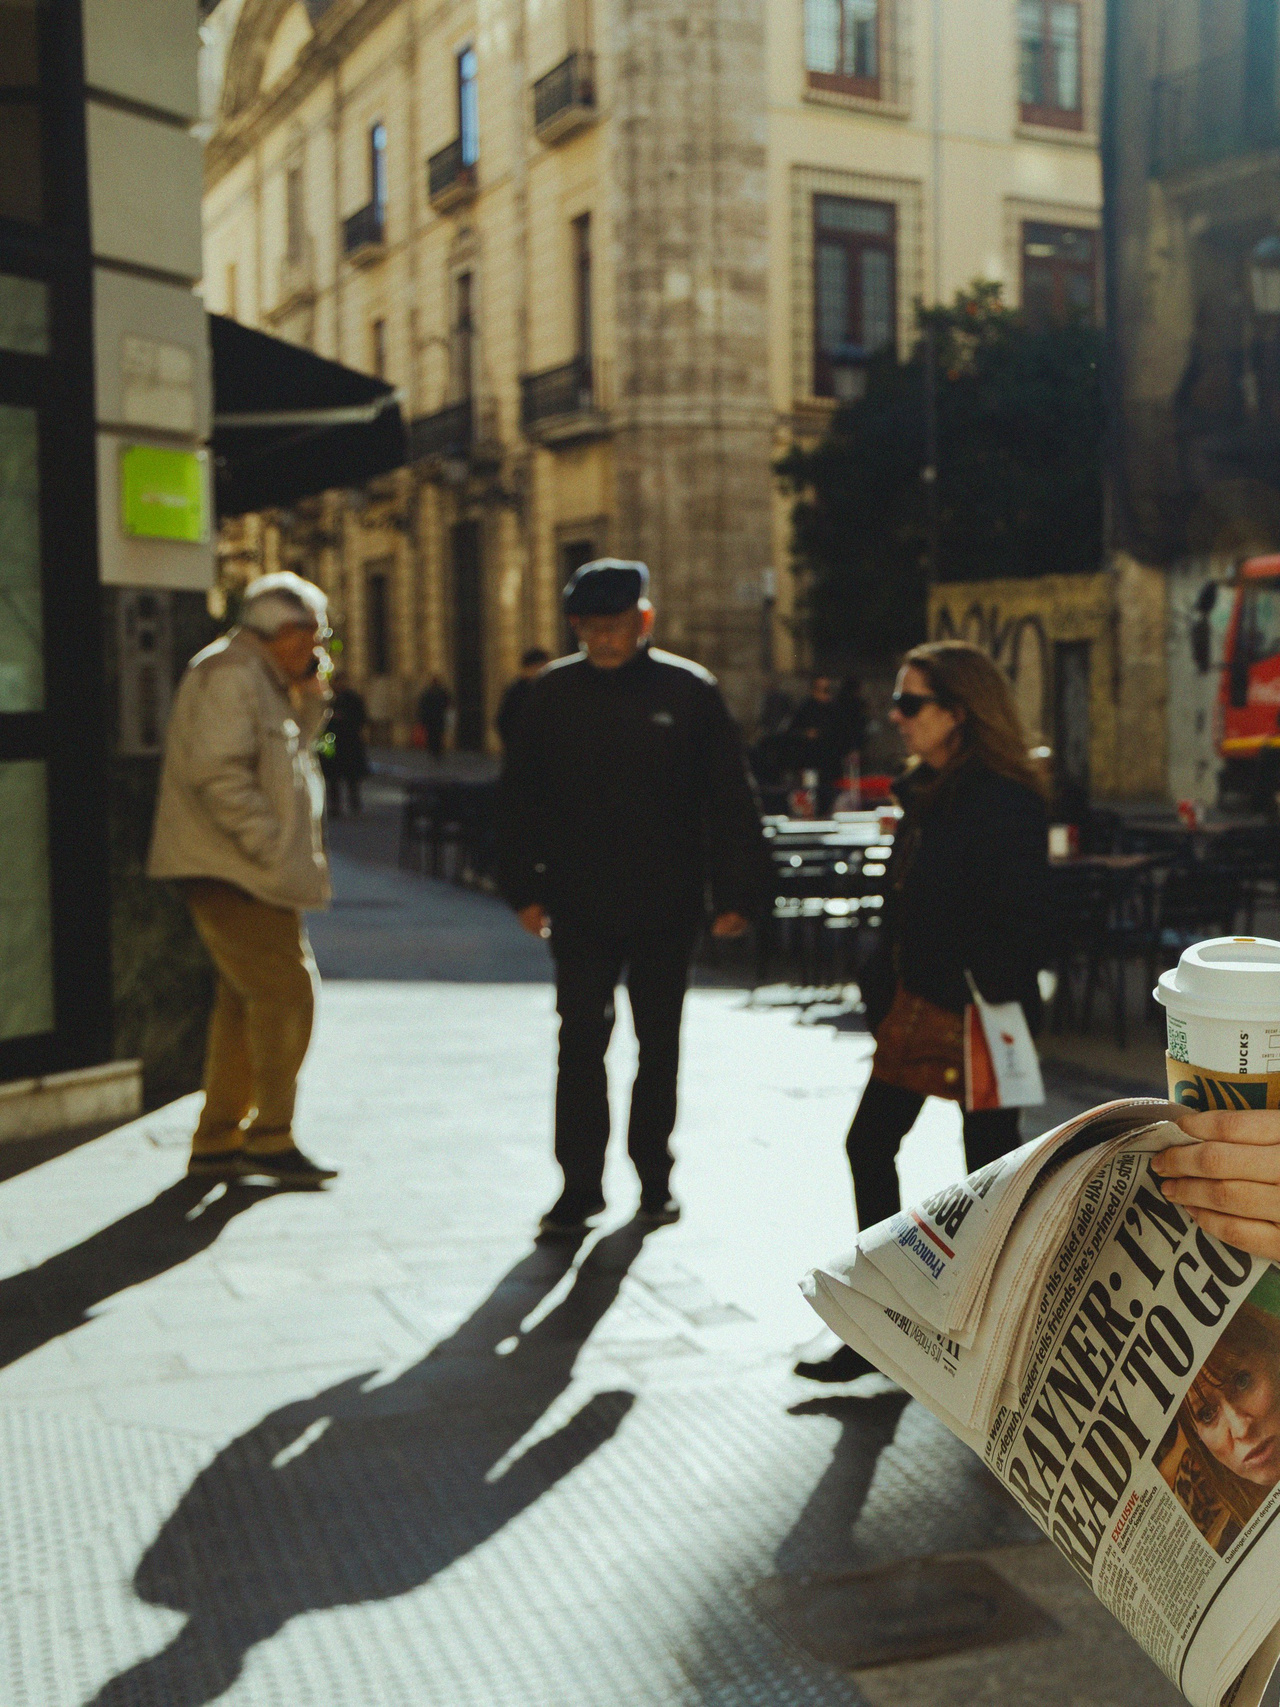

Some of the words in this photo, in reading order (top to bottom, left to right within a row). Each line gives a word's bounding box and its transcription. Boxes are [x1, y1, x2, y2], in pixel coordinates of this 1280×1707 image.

[1116, 1151, 1135, 1180] strike
[1085, 1180, 1103, 1204] HAS
[1112, 1179, 1127, 1196] to
[899, 1226, 918, 1247] off
[1077, 1203, 1095, 1236] aide
[1091, 1192, 1121, 1252] primed
[913, 1239, 945, 1279] France
[1059, 1231, 1080, 1273] chief
[1073, 1247, 1094, 1286] she's
[1046, 1271, 1061, 1296] his
[1040, 1293, 1049, 1314] or
[1048, 1283, 1076, 1335] friends
[931, 1343, 942, 1363] It's
[1009, 1272, 1143, 1527] RAYNER:
[1113, 1157, 1194, 1290] I'M
[1036, 1332, 1052, 1364] tells
[1019, 1361, 1039, 1409] leader
[989, 1406, 1007, 1440] warn
[1044, 1386, 1151, 1593] READY
[1120, 1305, 1194, 1415] TO
[1173, 1225, 1252, 1327] GO
[996, 1410, 1022, 1472] ex-deputy
[1111, 1491, 1139, 1542] EXCLUSIVE
[1121, 1537, 1130, 1554] Owen
[1134, 1507, 1146, 1527] Sophie
[1144, 1486, 1157, 1507] Church
[1121, 1524, 1130, 1541] Jason
[1225, 1537, 1246, 1564] Challenge:
[1244, 1517, 1260, 1537] Former
[1260, 1498, 1275, 1518] deputy
[1189, 1609, 1197, 1623] Page
